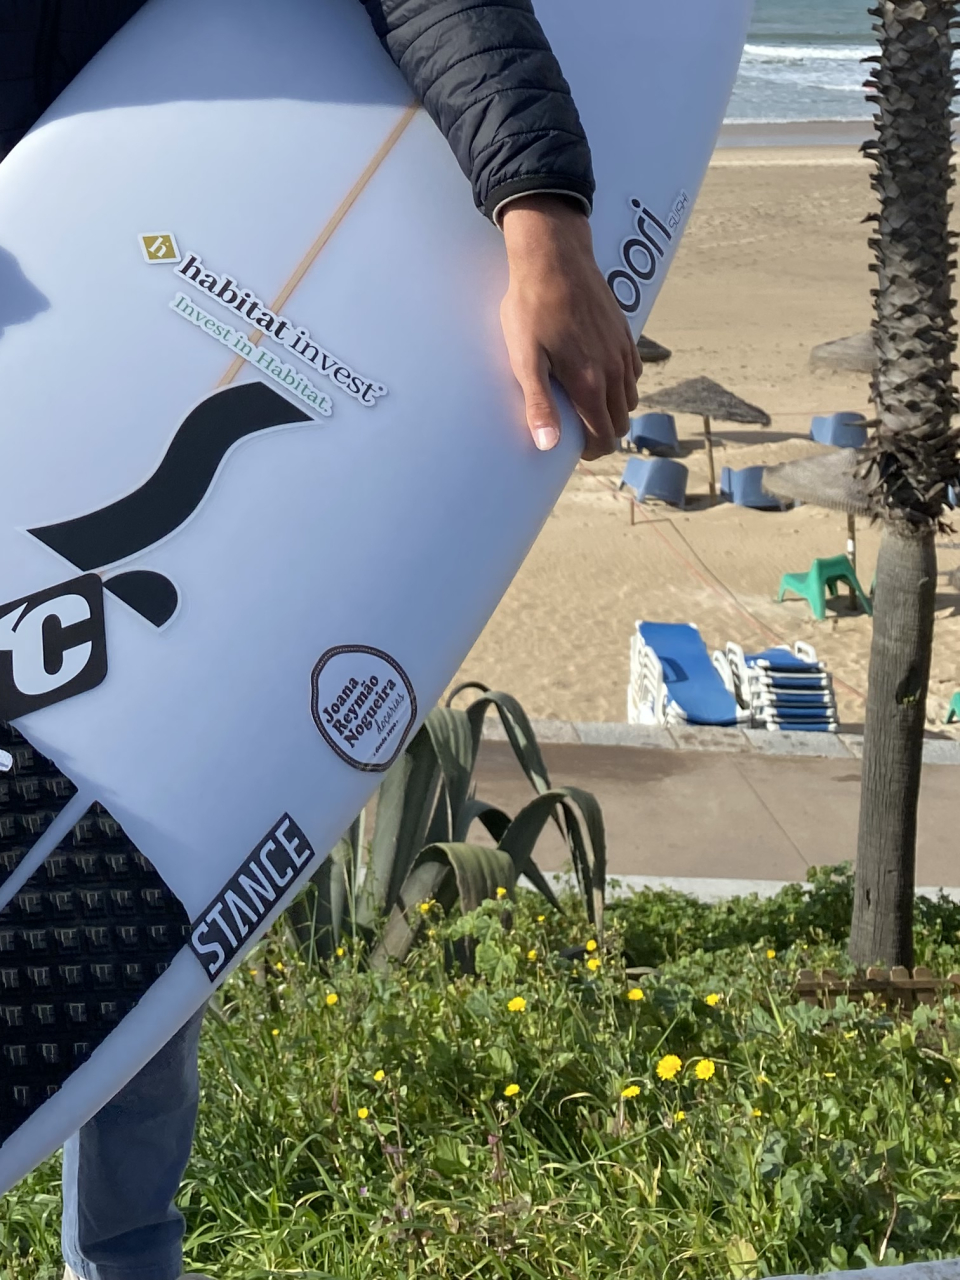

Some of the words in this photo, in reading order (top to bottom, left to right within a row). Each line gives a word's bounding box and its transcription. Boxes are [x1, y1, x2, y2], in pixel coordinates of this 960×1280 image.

[178, 254, 291, 340] habitat
[607, 198, 672, 313] oori
[174, 296, 233, 342] Invest
[234, 335, 252, 357] in
[254, 350, 329, 413] Habitat.
[323, 677, 360, 724] Joana
[332, 675, 379, 736] Reymão
[343, 679, 397, 749] Nogueira
[191, 818, 311, 975] STANCE
